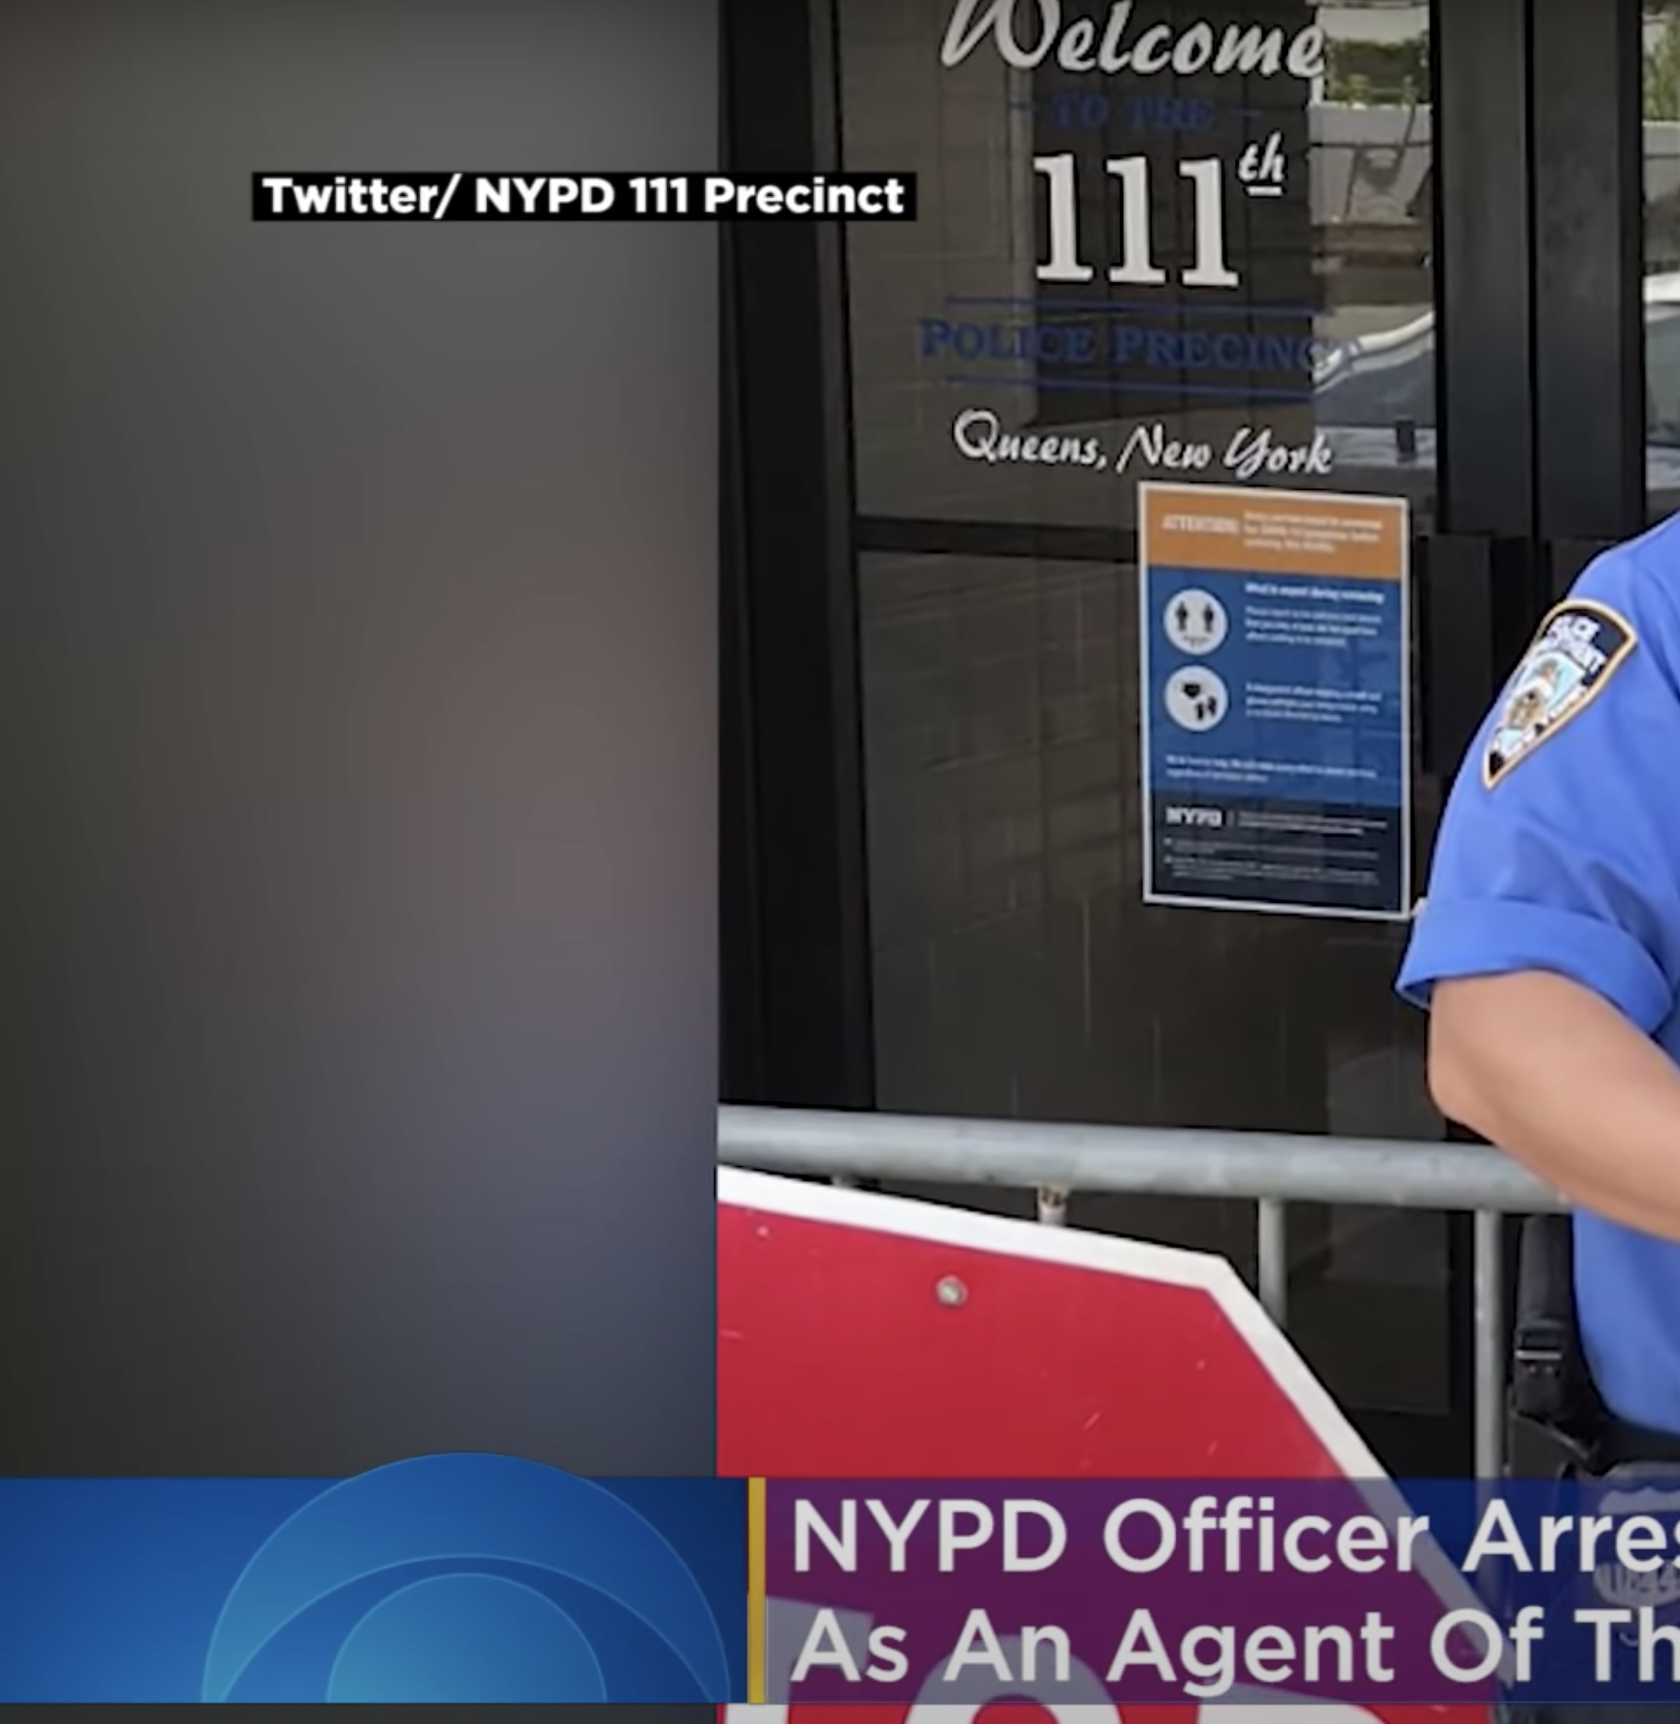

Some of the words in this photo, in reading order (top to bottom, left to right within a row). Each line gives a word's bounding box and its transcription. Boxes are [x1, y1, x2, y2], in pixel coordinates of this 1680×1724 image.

[942, 0, 1324, 78] Welcome
[1052, 95, 1110, 127] TO
[921, 319, 1095, 364] POLICE
[954, 410, 1108, 470] Queens,
[1116, 424, 1209, 472] New
[1222, 427, 1333, 477] York
